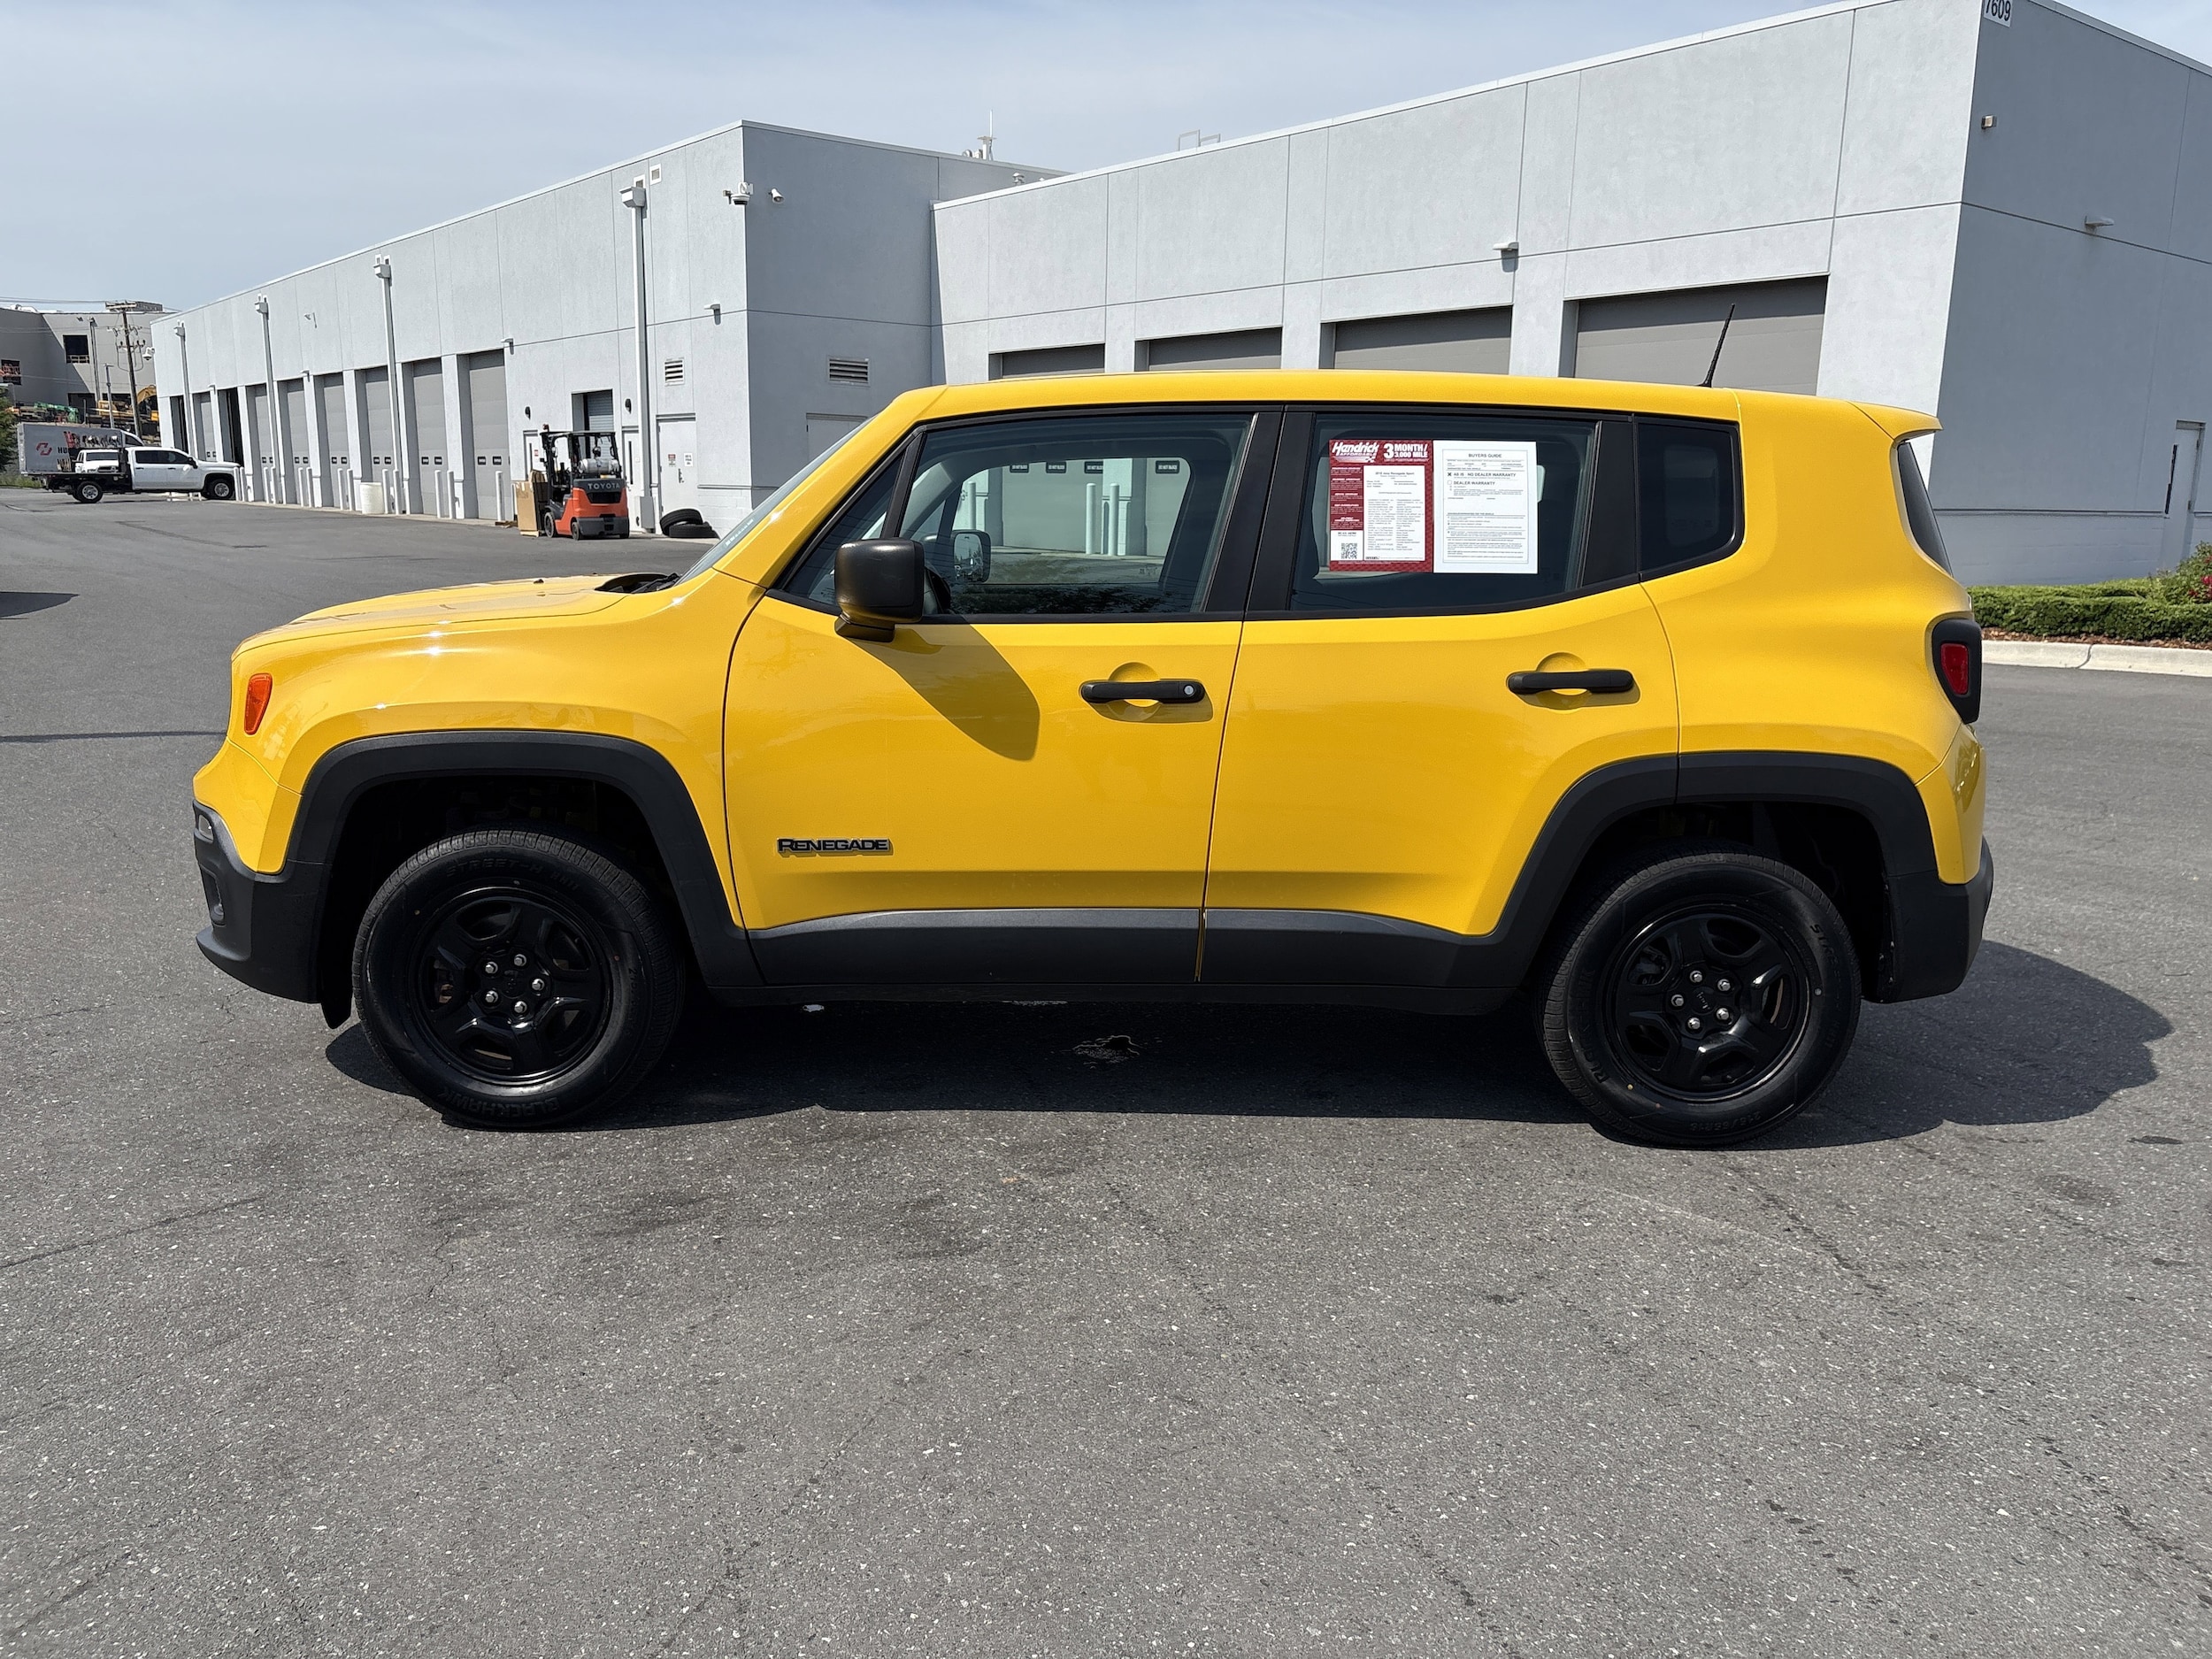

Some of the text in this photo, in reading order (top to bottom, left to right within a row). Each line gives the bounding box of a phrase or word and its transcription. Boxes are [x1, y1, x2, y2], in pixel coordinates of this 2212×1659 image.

[1384, 443, 1394, 458] 3
[1394, 443, 1428, 452] MONTH/
[778, 838, 889, 852] RENEGADE
